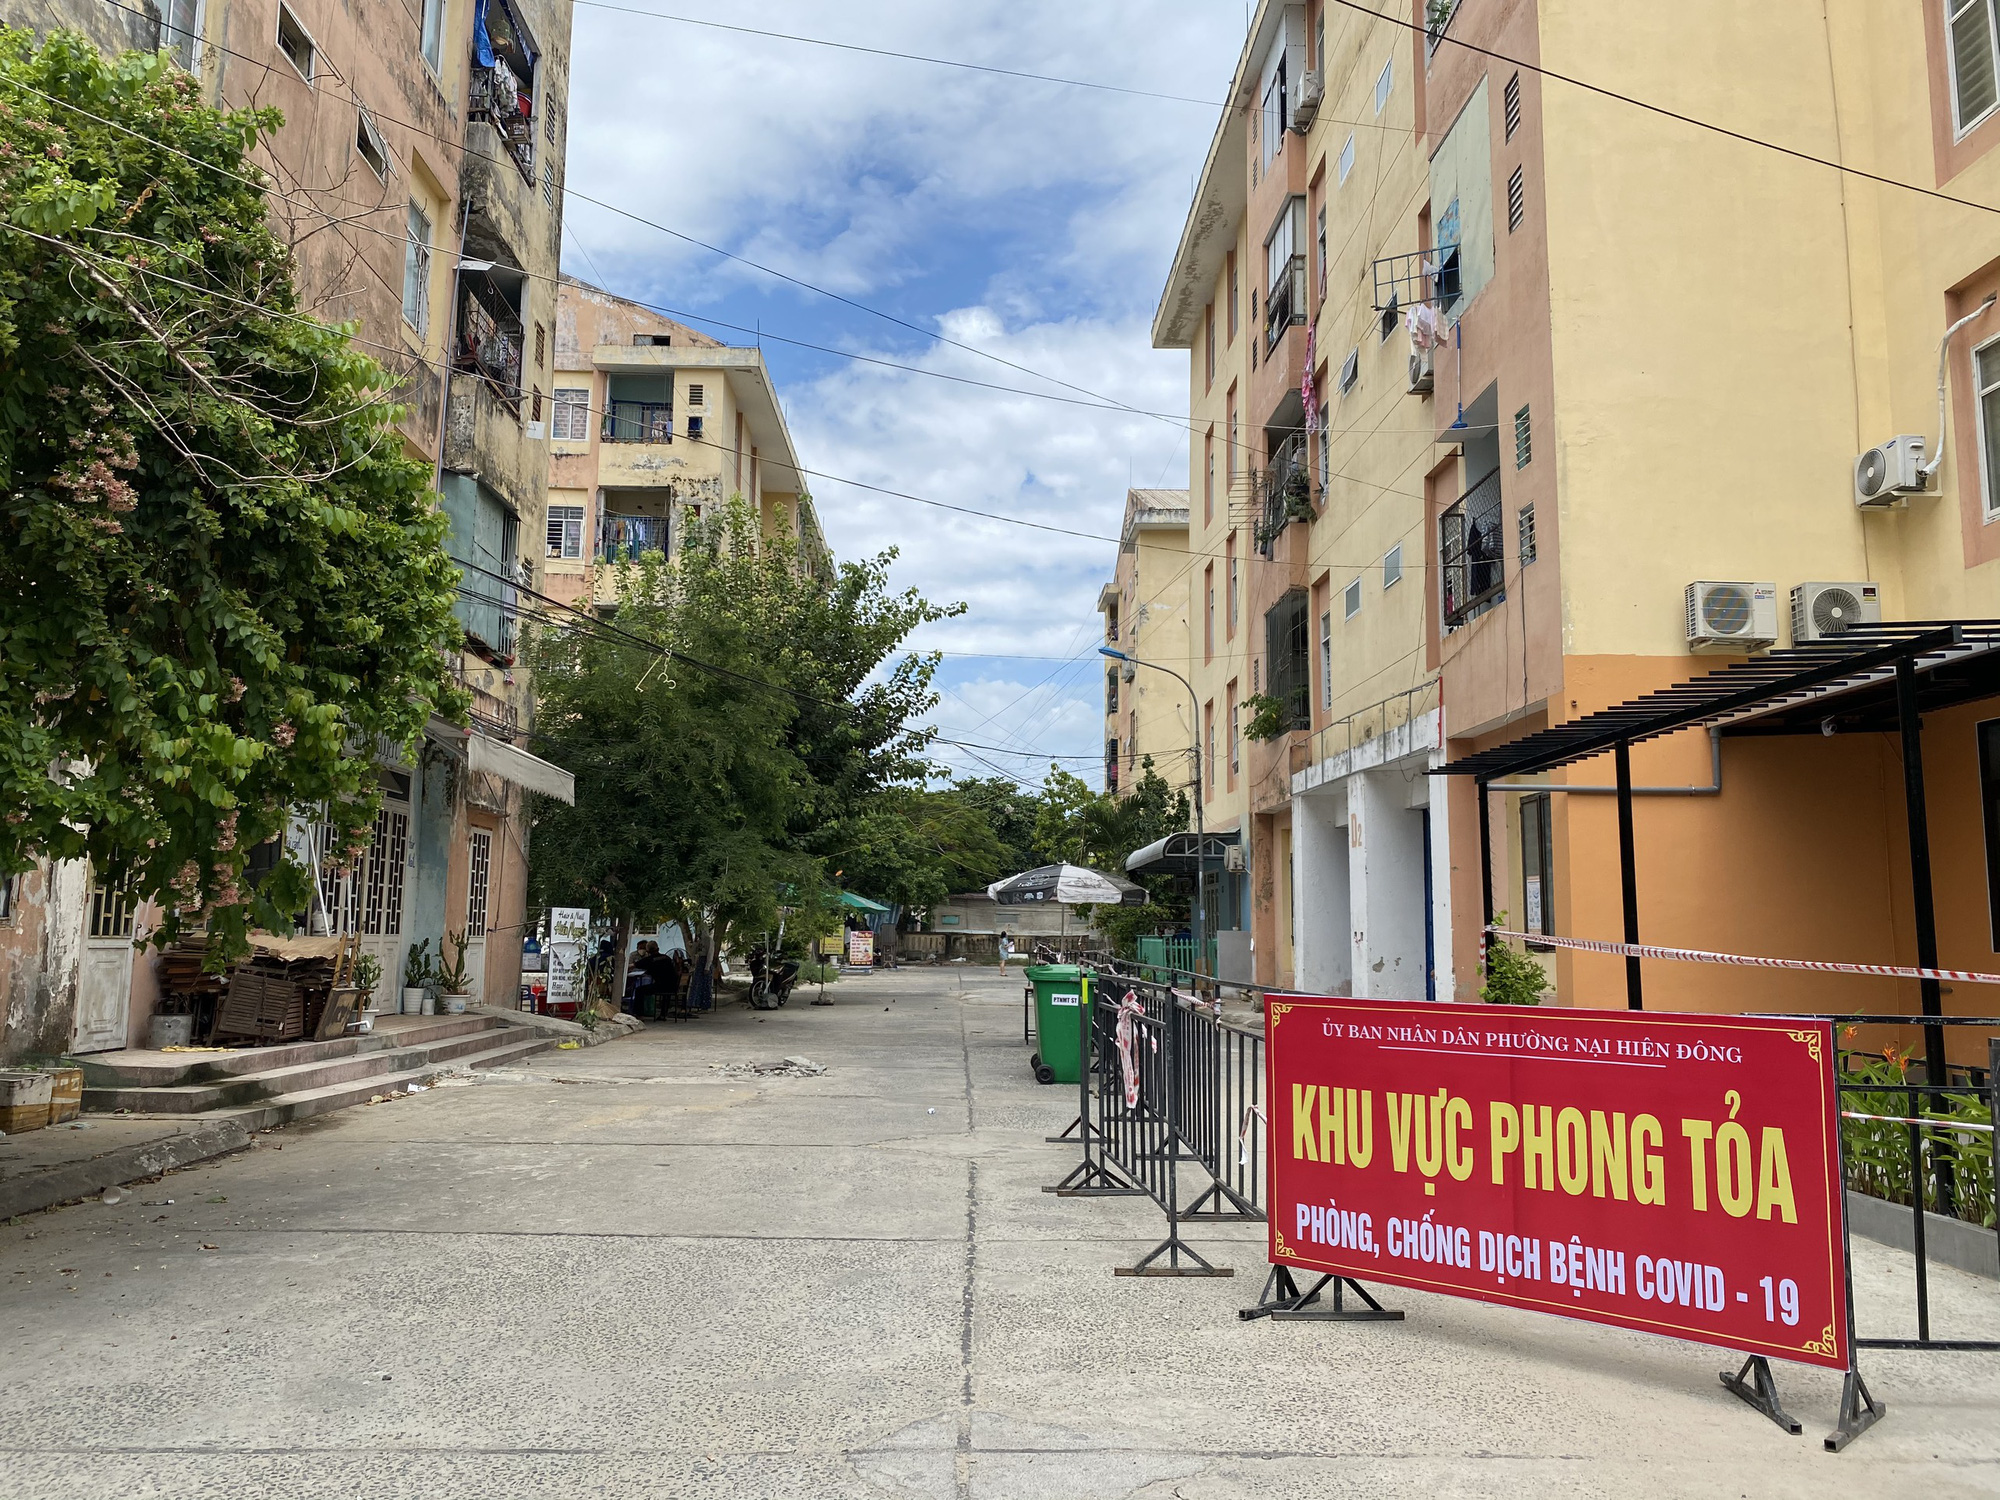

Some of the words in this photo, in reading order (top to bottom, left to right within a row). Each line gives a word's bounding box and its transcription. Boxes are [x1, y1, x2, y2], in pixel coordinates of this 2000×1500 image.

[1322, 1018, 1344, 1037] ỦY
[1349, 1025, 1382, 1040] BAN
[1387, 1024, 1437, 1043] NHÂN
[1442, 1026, 1480, 1046] DÂN
[1485, 1029, 1569, 1052] PHƯỜNG
[1574, 1037, 1611, 1058] NẠI
[1616, 1037, 1670, 1058] HIÊN
[1676, 1040, 1743, 1064] ĐÔNG
[1292, 1083, 1373, 1168] KHU
[1386, 1088, 1474, 1197] VỰC
[1490, 1101, 1666, 1207] PHONG
[1681, 1089, 1799, 1225] TỎA
[1296, 1198, 1380, 1259] PHÒNG,
[1387, 1208, 1471, 1269] CHỐNG
[1478, 1231, 1541, 1284] DỊCH
[1550, 1235, 1626, 1299] BỆNH
[1635, 1255, 1725, 1312] COVID
[1759, 1275, 1800, 1326] 19
